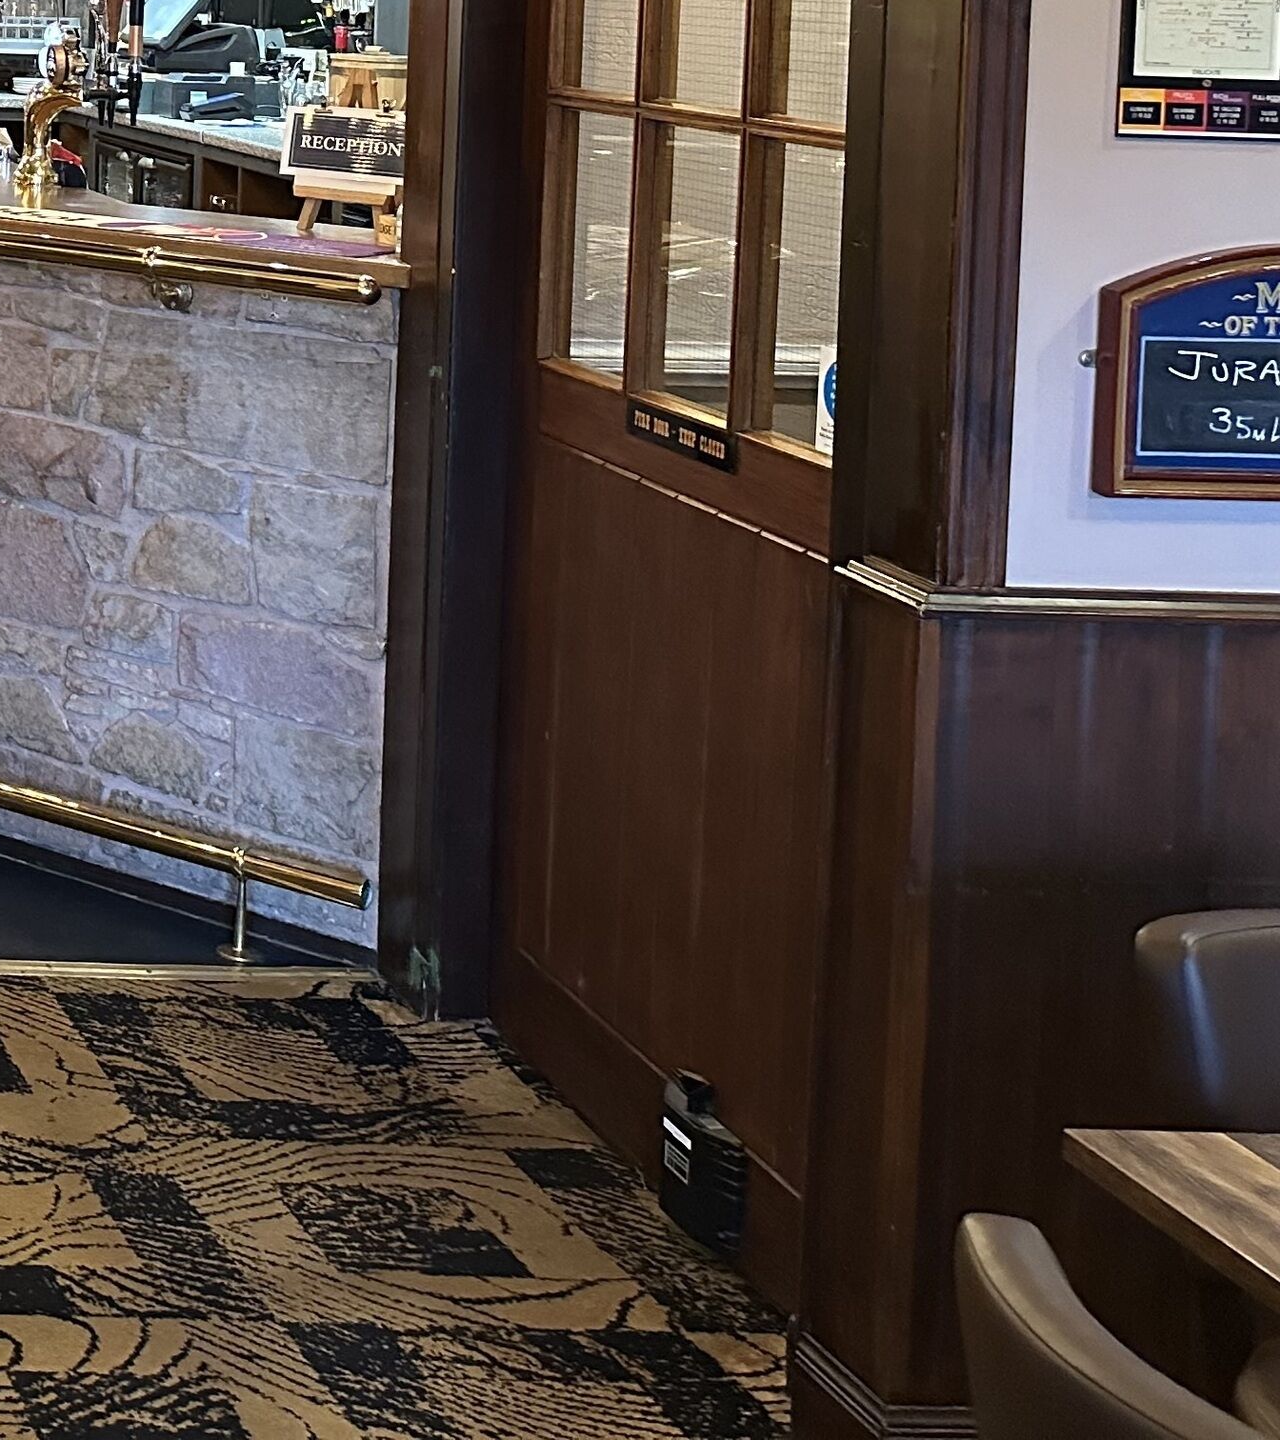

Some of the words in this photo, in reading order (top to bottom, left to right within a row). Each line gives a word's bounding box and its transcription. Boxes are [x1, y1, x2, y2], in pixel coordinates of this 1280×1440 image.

[300, 134, 405, 158] RECEPTION
[1223, 315, 1258, 336] OF
[1168, 349, 1280, 387] JURA
